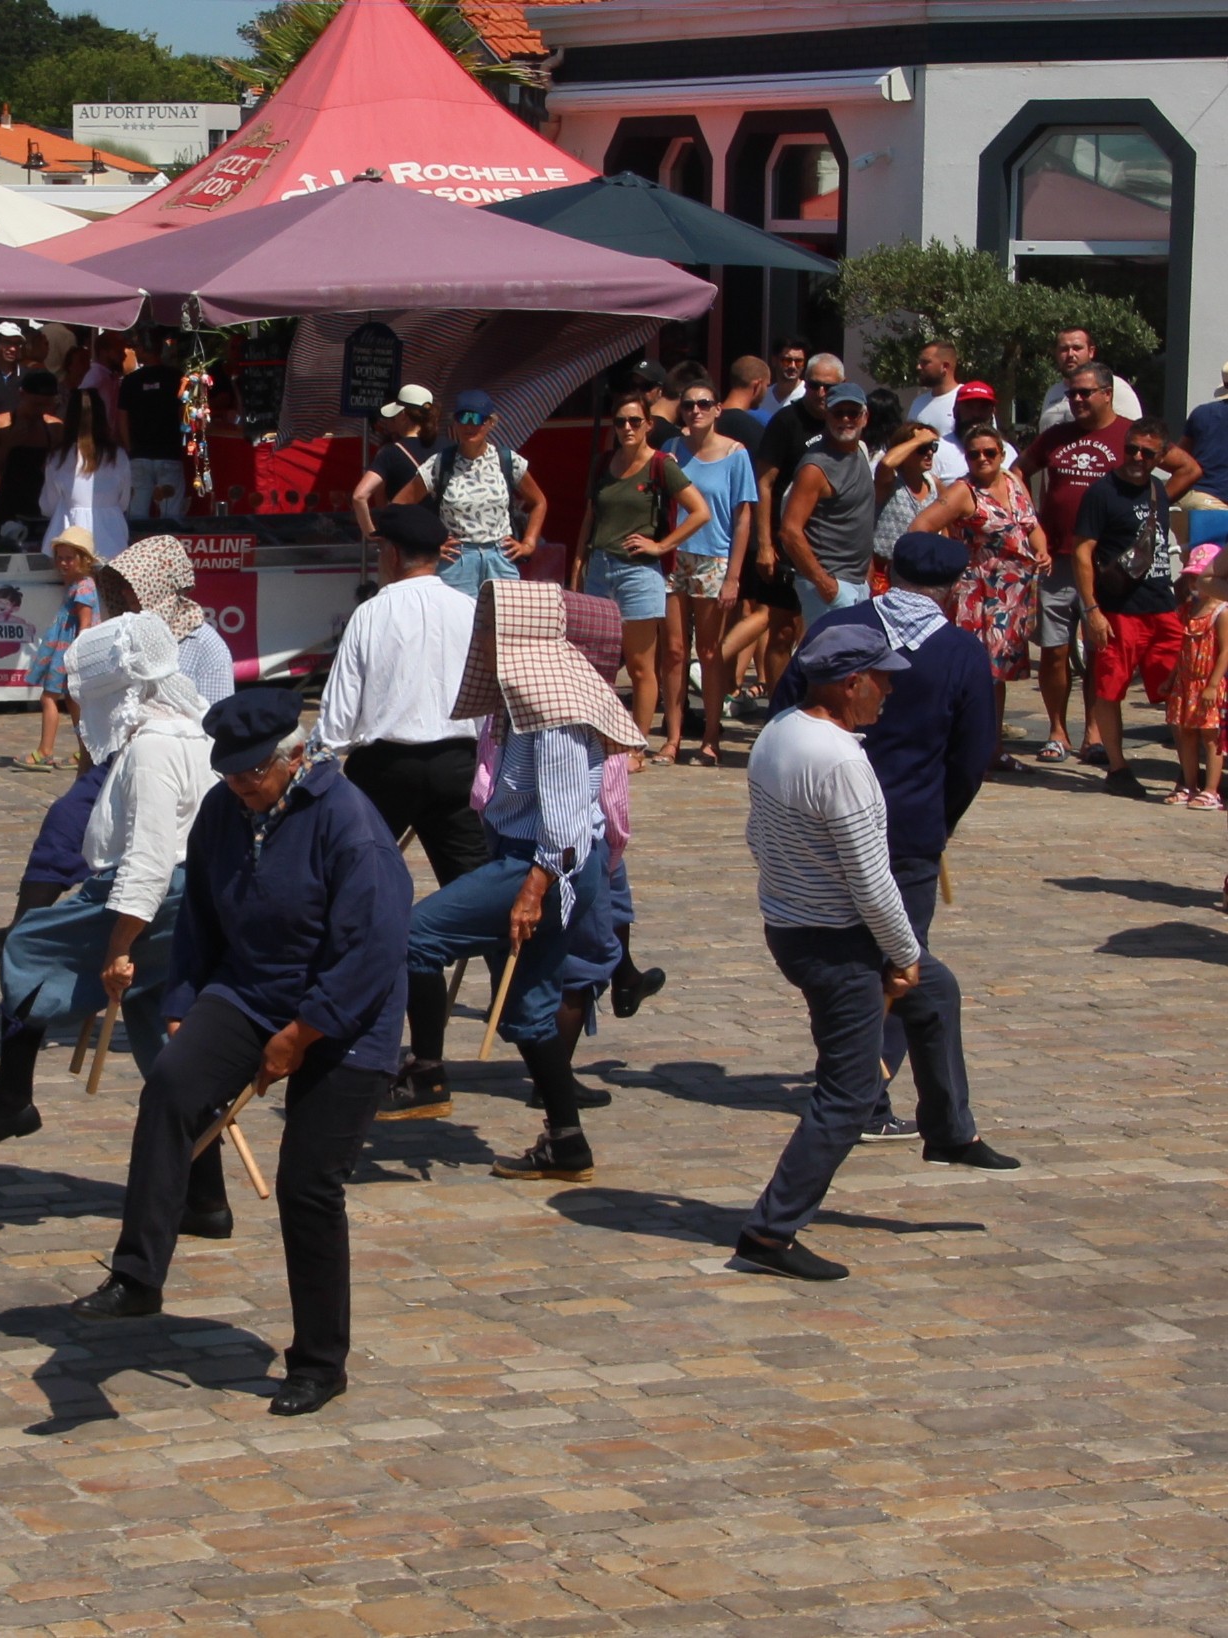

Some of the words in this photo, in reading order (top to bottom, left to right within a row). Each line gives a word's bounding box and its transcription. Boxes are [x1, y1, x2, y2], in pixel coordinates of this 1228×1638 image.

[79, 107, 100, 119] AU
[105, 106, 144, 119] PORT
[148, 106, 199, 119] PUNAY
[388, 161, 569, 182] ROCHELLE
[1055, 442, 1077, 459] SPEED
[1092, 441, 1117, 462] GARAGE
[180, 538, 252, 553] RALINE
[11, 673, 21, 681] ET
